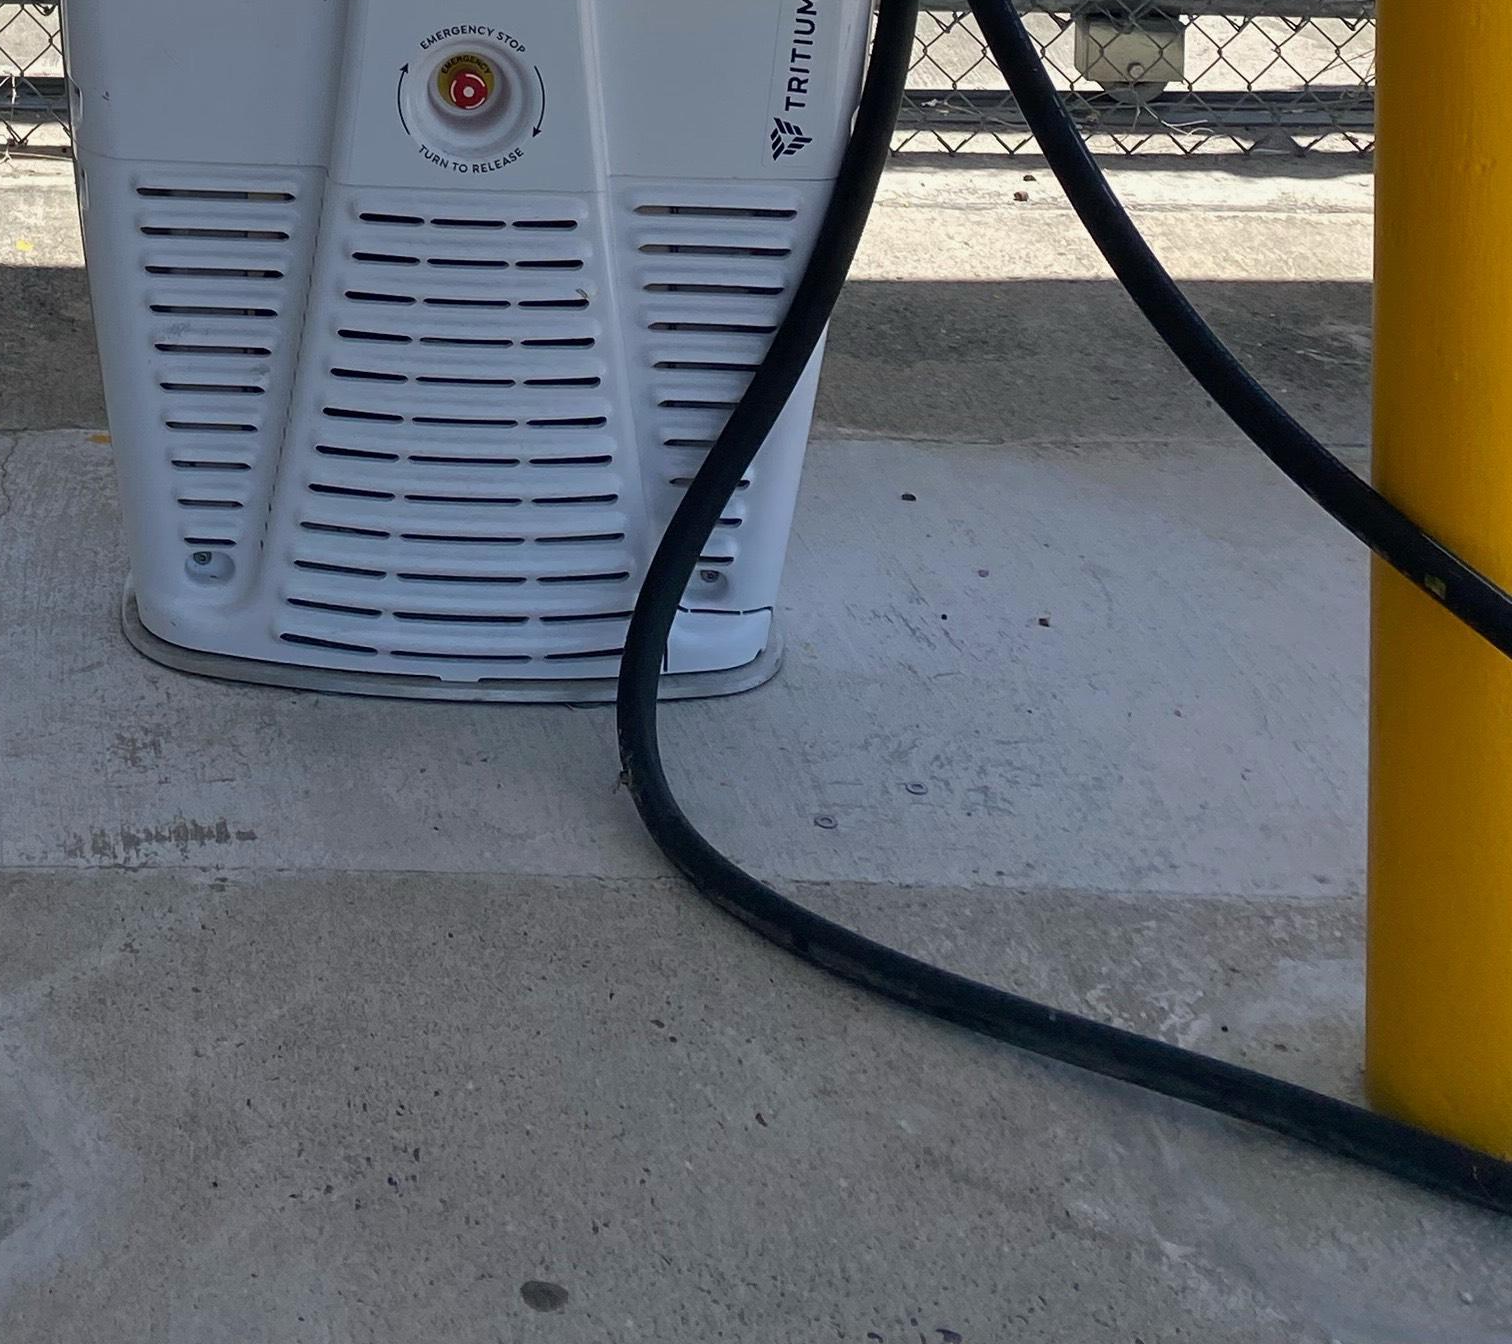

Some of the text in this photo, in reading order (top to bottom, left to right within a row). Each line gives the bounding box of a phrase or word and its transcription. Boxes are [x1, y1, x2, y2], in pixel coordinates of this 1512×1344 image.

[419, 24, 527, 54] EMERGENCY STOP
[441, 54, 492, 75] EMERGENCY
[418, 144, 525, 174] TURN TO RELEASE
